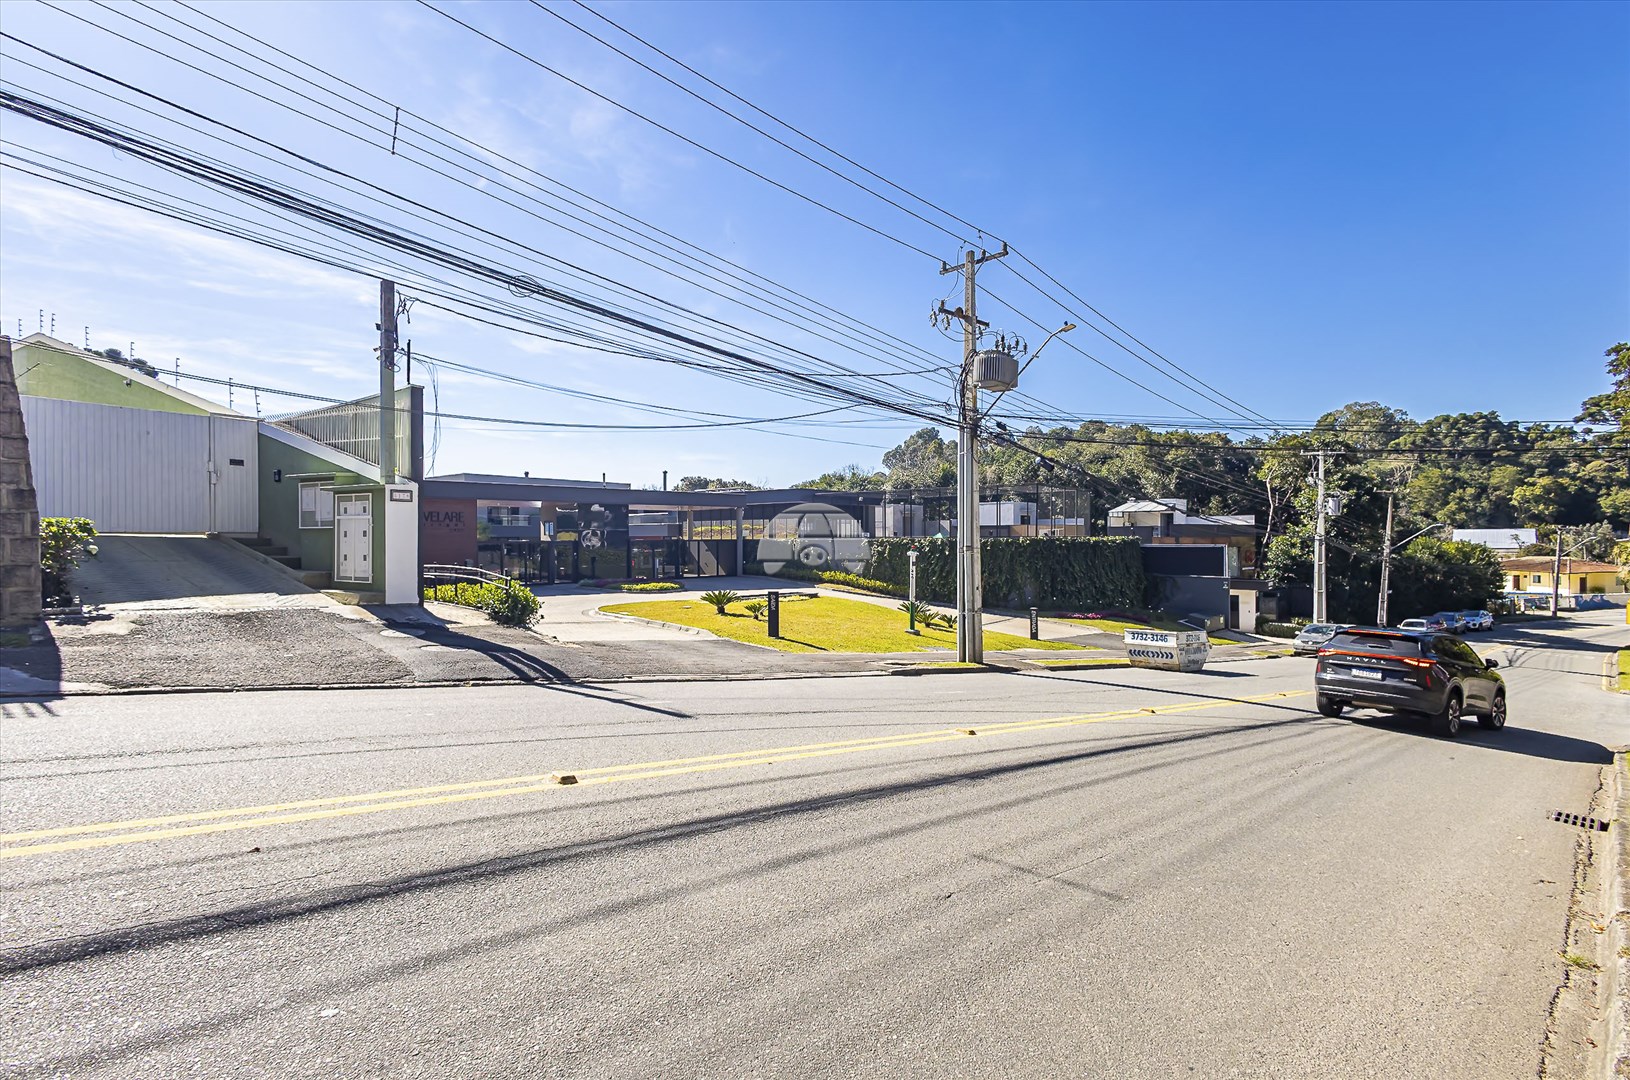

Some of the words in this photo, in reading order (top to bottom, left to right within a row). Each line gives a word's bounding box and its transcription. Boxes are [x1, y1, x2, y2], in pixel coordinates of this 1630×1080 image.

[424, 511, 464, 523] VELARE
[1130, 632, 1169, 643] 3732-3146
[1346, 656, 1387, 665] HAVAL
